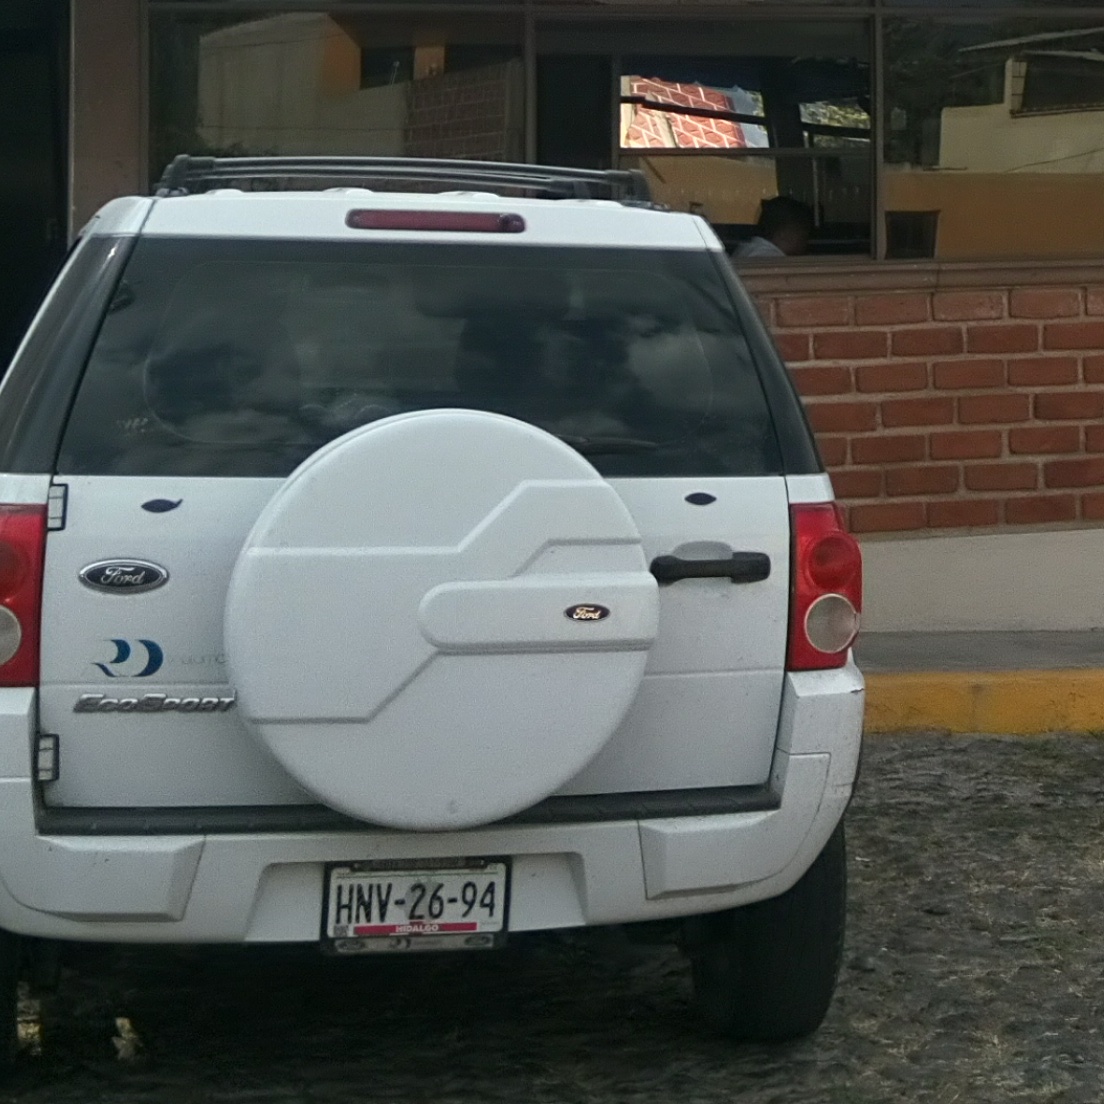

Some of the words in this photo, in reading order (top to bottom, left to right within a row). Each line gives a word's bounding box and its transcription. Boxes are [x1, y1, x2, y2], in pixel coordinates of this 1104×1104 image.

[101, 566, 146, 585] Ford
[572, 606, 602, 620] Ford
[336, 881, 496, 925] HNV-26-94
[395, 923, 440, 934] HIDALGO
